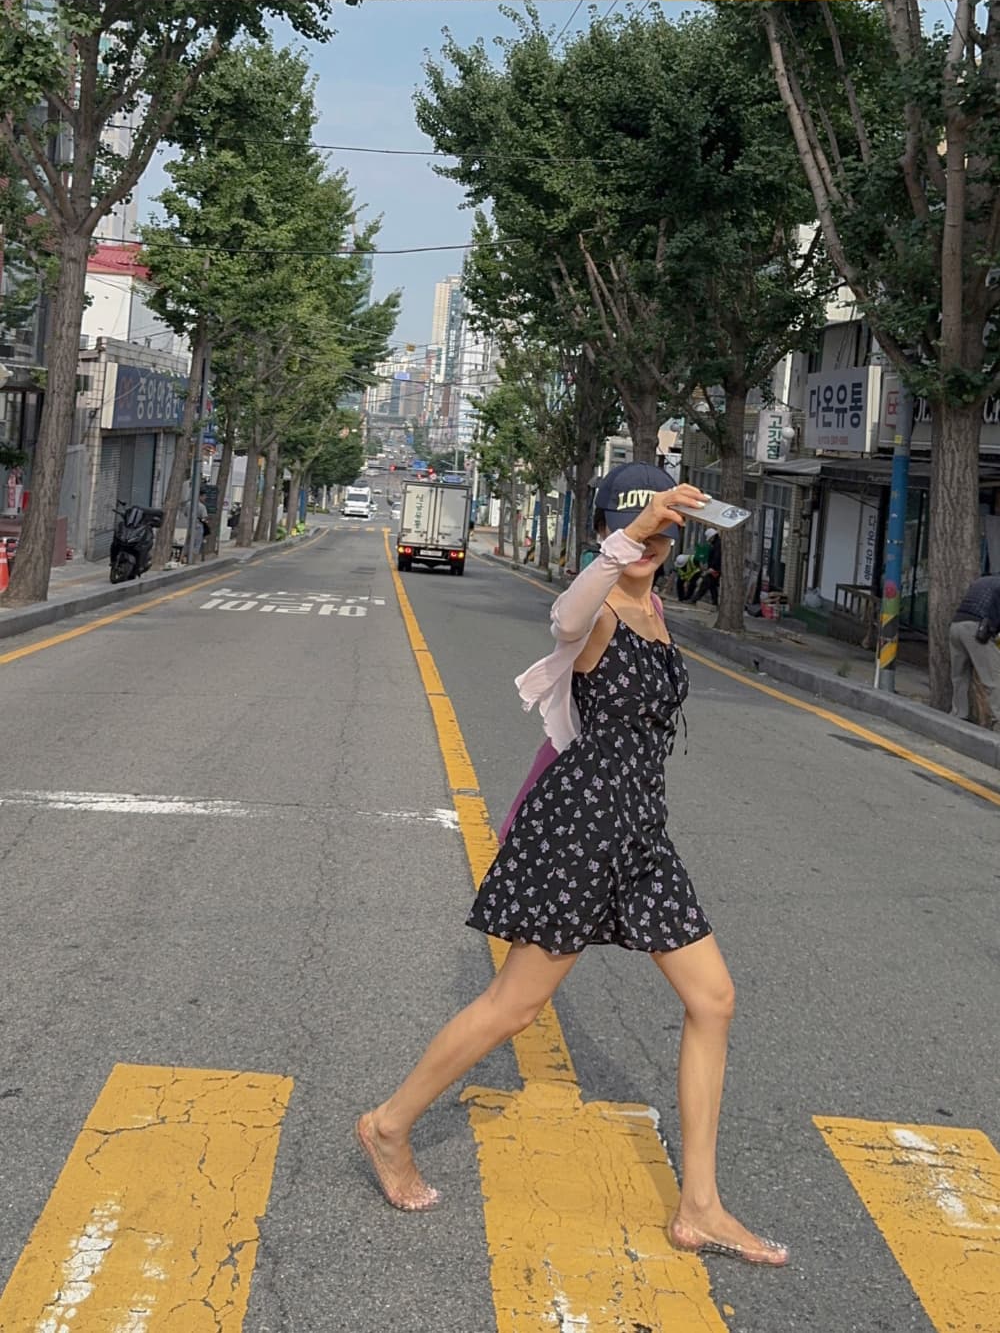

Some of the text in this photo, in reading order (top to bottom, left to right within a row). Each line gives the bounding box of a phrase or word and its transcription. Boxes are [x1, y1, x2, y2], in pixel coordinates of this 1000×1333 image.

[808, 382, 863, 429] 다온유통
[616, 489, 655, 511] LOV
[199, 598, 370, 617] 어린이
